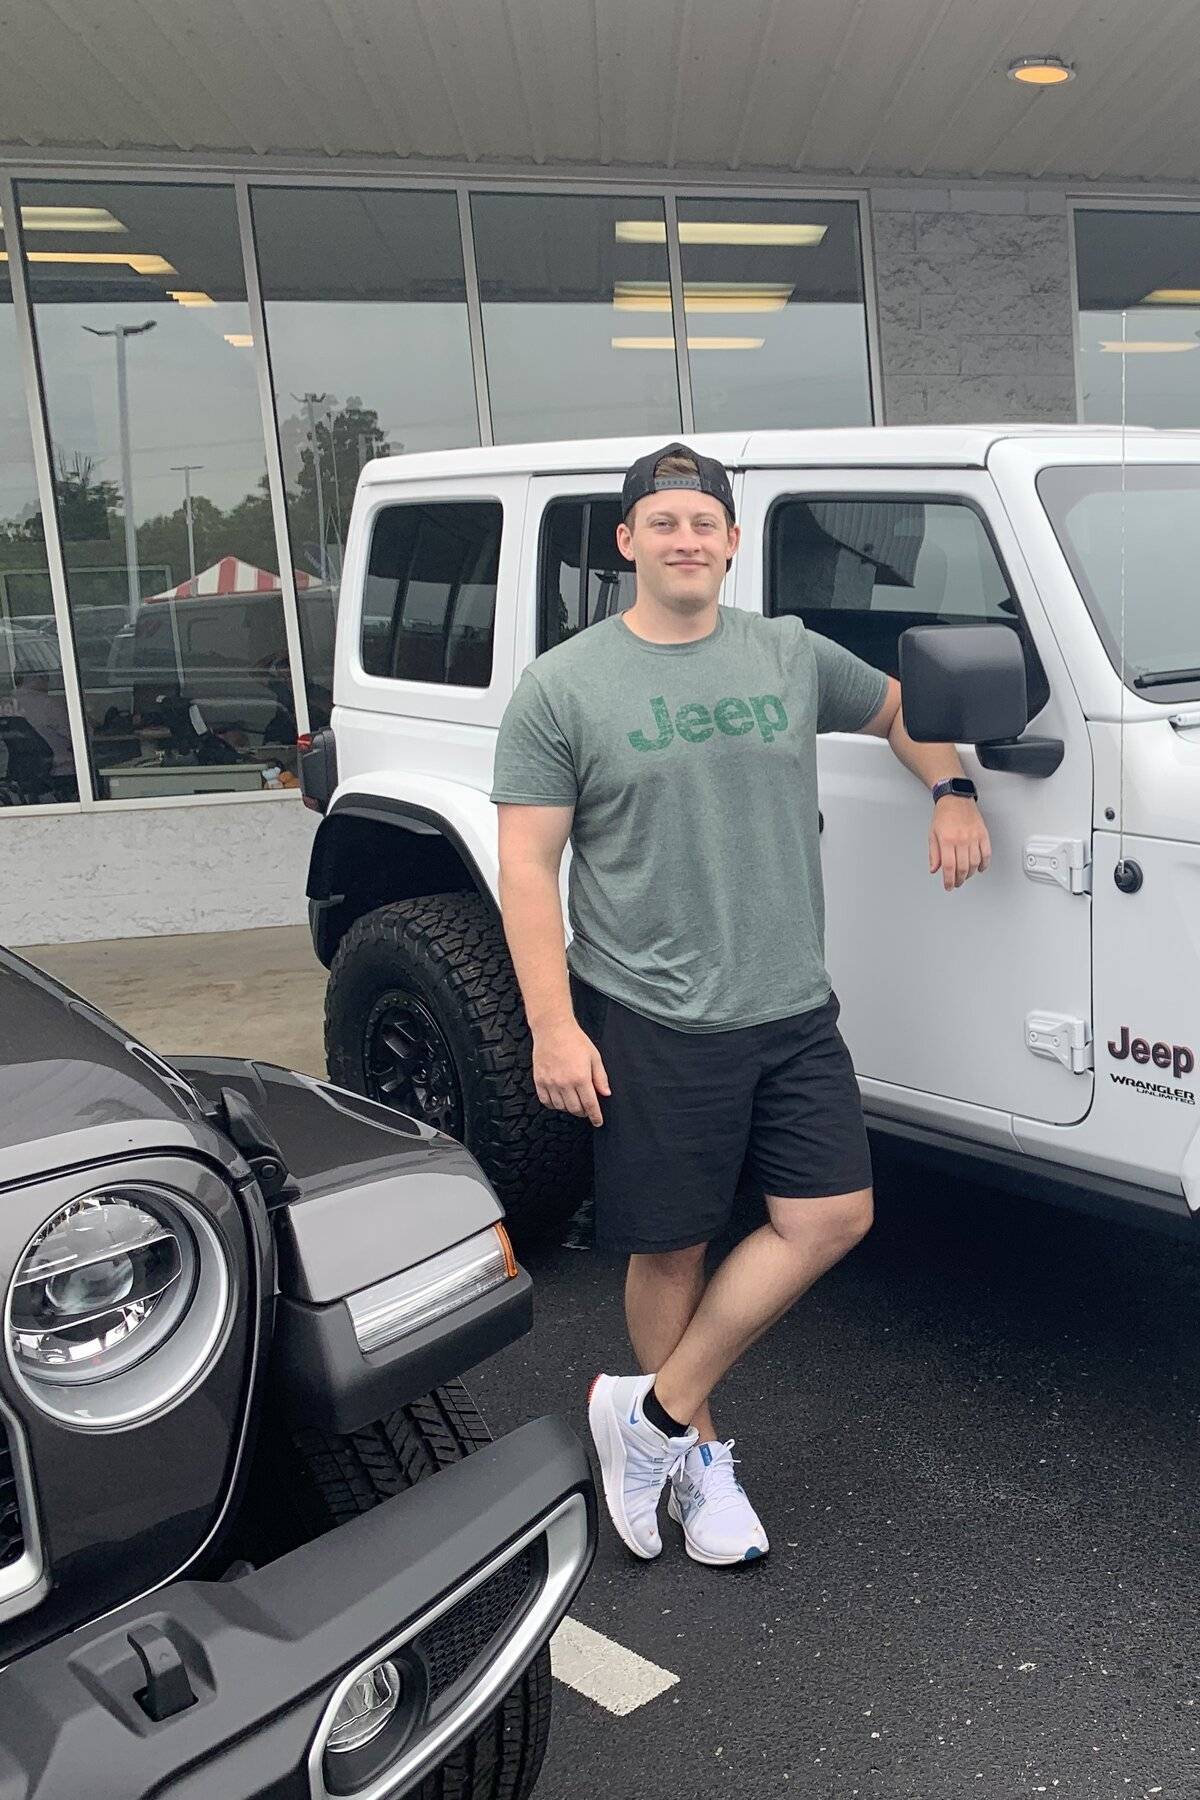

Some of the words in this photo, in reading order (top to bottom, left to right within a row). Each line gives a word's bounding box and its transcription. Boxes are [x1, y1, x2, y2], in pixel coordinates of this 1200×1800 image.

[625, 694, 789, 752] Jeep
[1107, 1026, 1195, 1079] Jeep
[1109, 1073, 1195, 1101] WRANGLER
[1136, 1088, 1196, 1106] UNLIMITED
